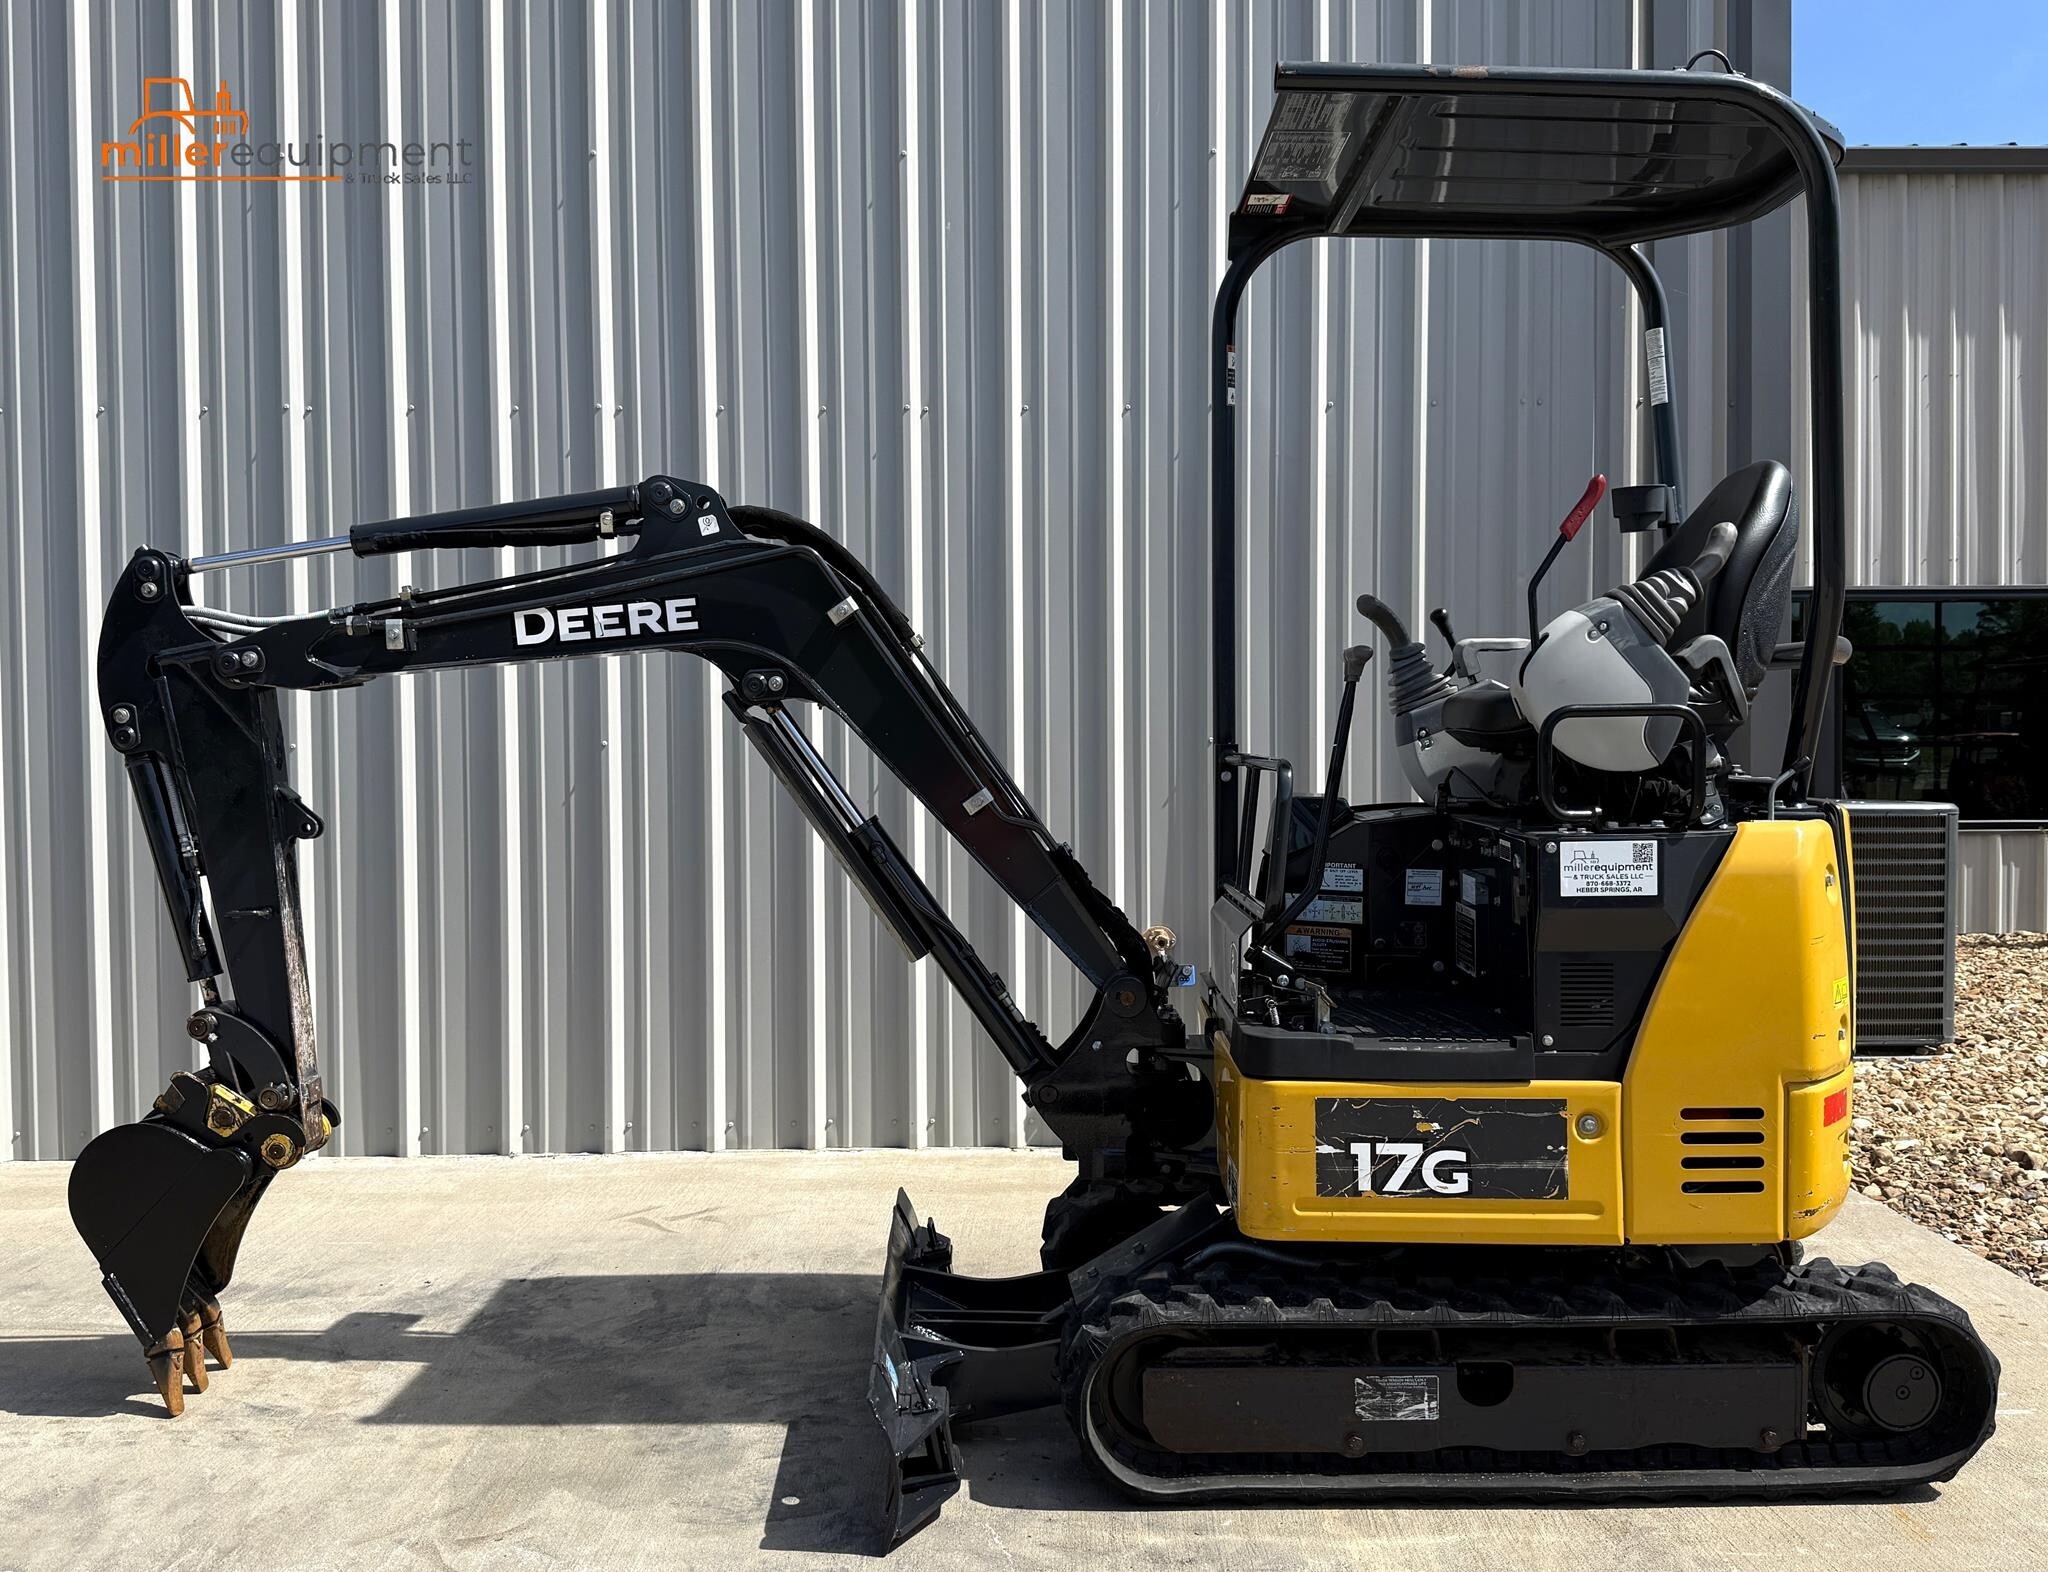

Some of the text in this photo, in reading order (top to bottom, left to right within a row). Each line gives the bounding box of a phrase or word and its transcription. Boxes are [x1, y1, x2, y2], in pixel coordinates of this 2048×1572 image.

[513, 597, 699, 646] DEERE
[1563, 863, 1653, 873] millerequipment
[1303, 928, 1340, 936] WARNING
[1350, 1143, 1469, 1194] 17G
